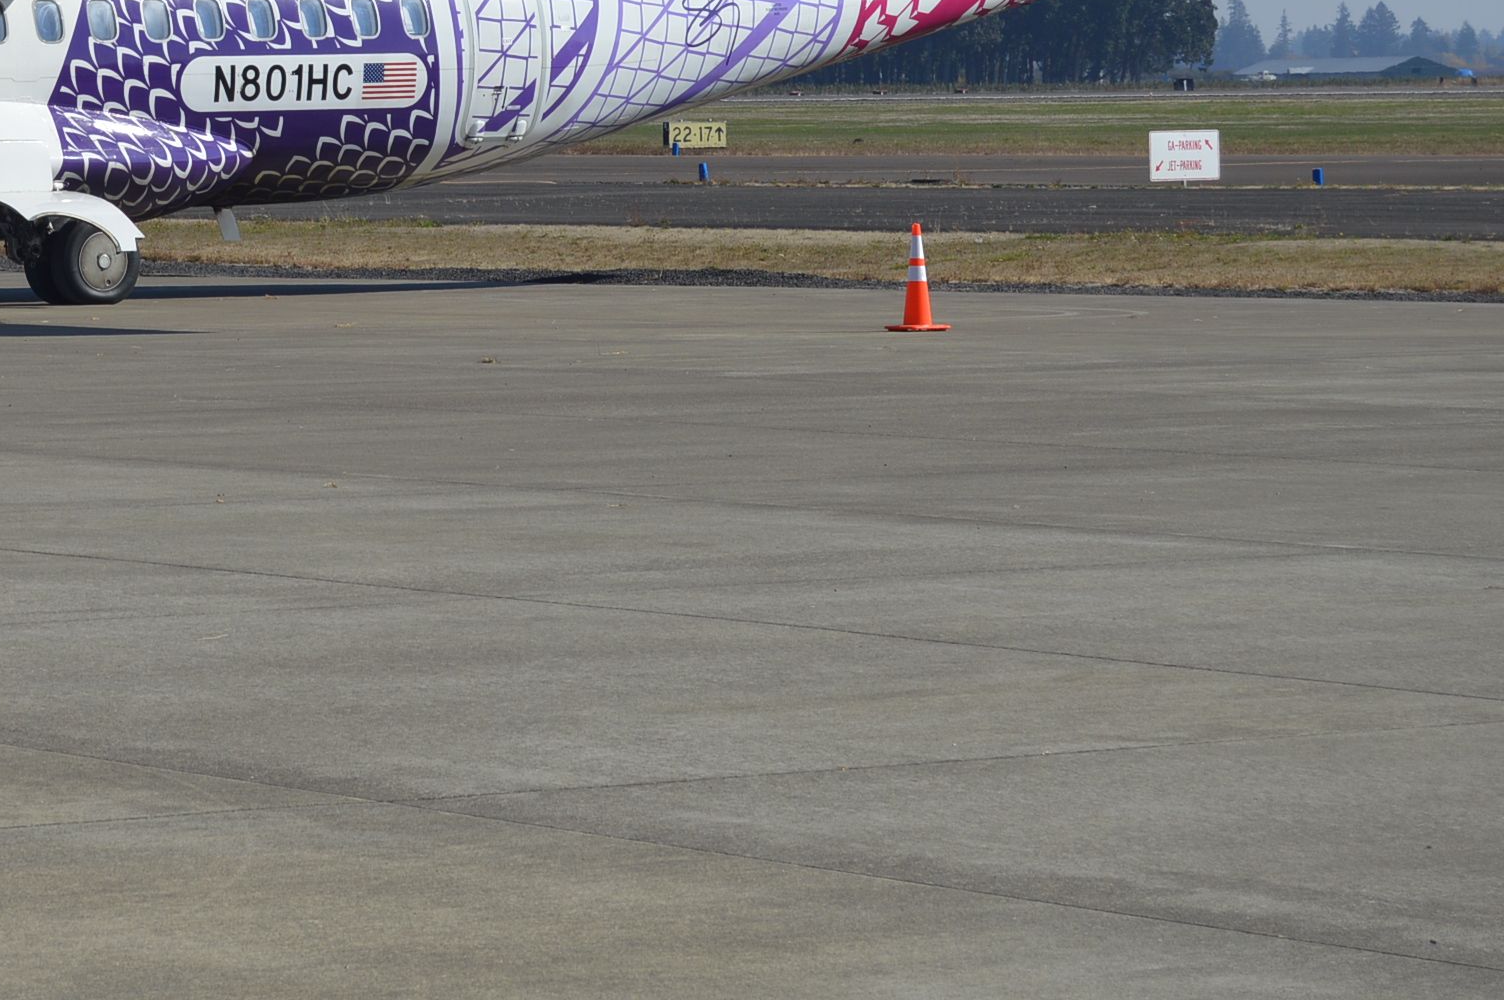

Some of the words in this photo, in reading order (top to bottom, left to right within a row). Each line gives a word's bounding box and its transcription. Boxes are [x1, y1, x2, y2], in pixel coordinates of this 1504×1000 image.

[213, 63, 354, 103] N801HC
[1168, 140, 1202, 151] GA-PARKING
[1167, 160, 1202, 172] JET-PARKING
